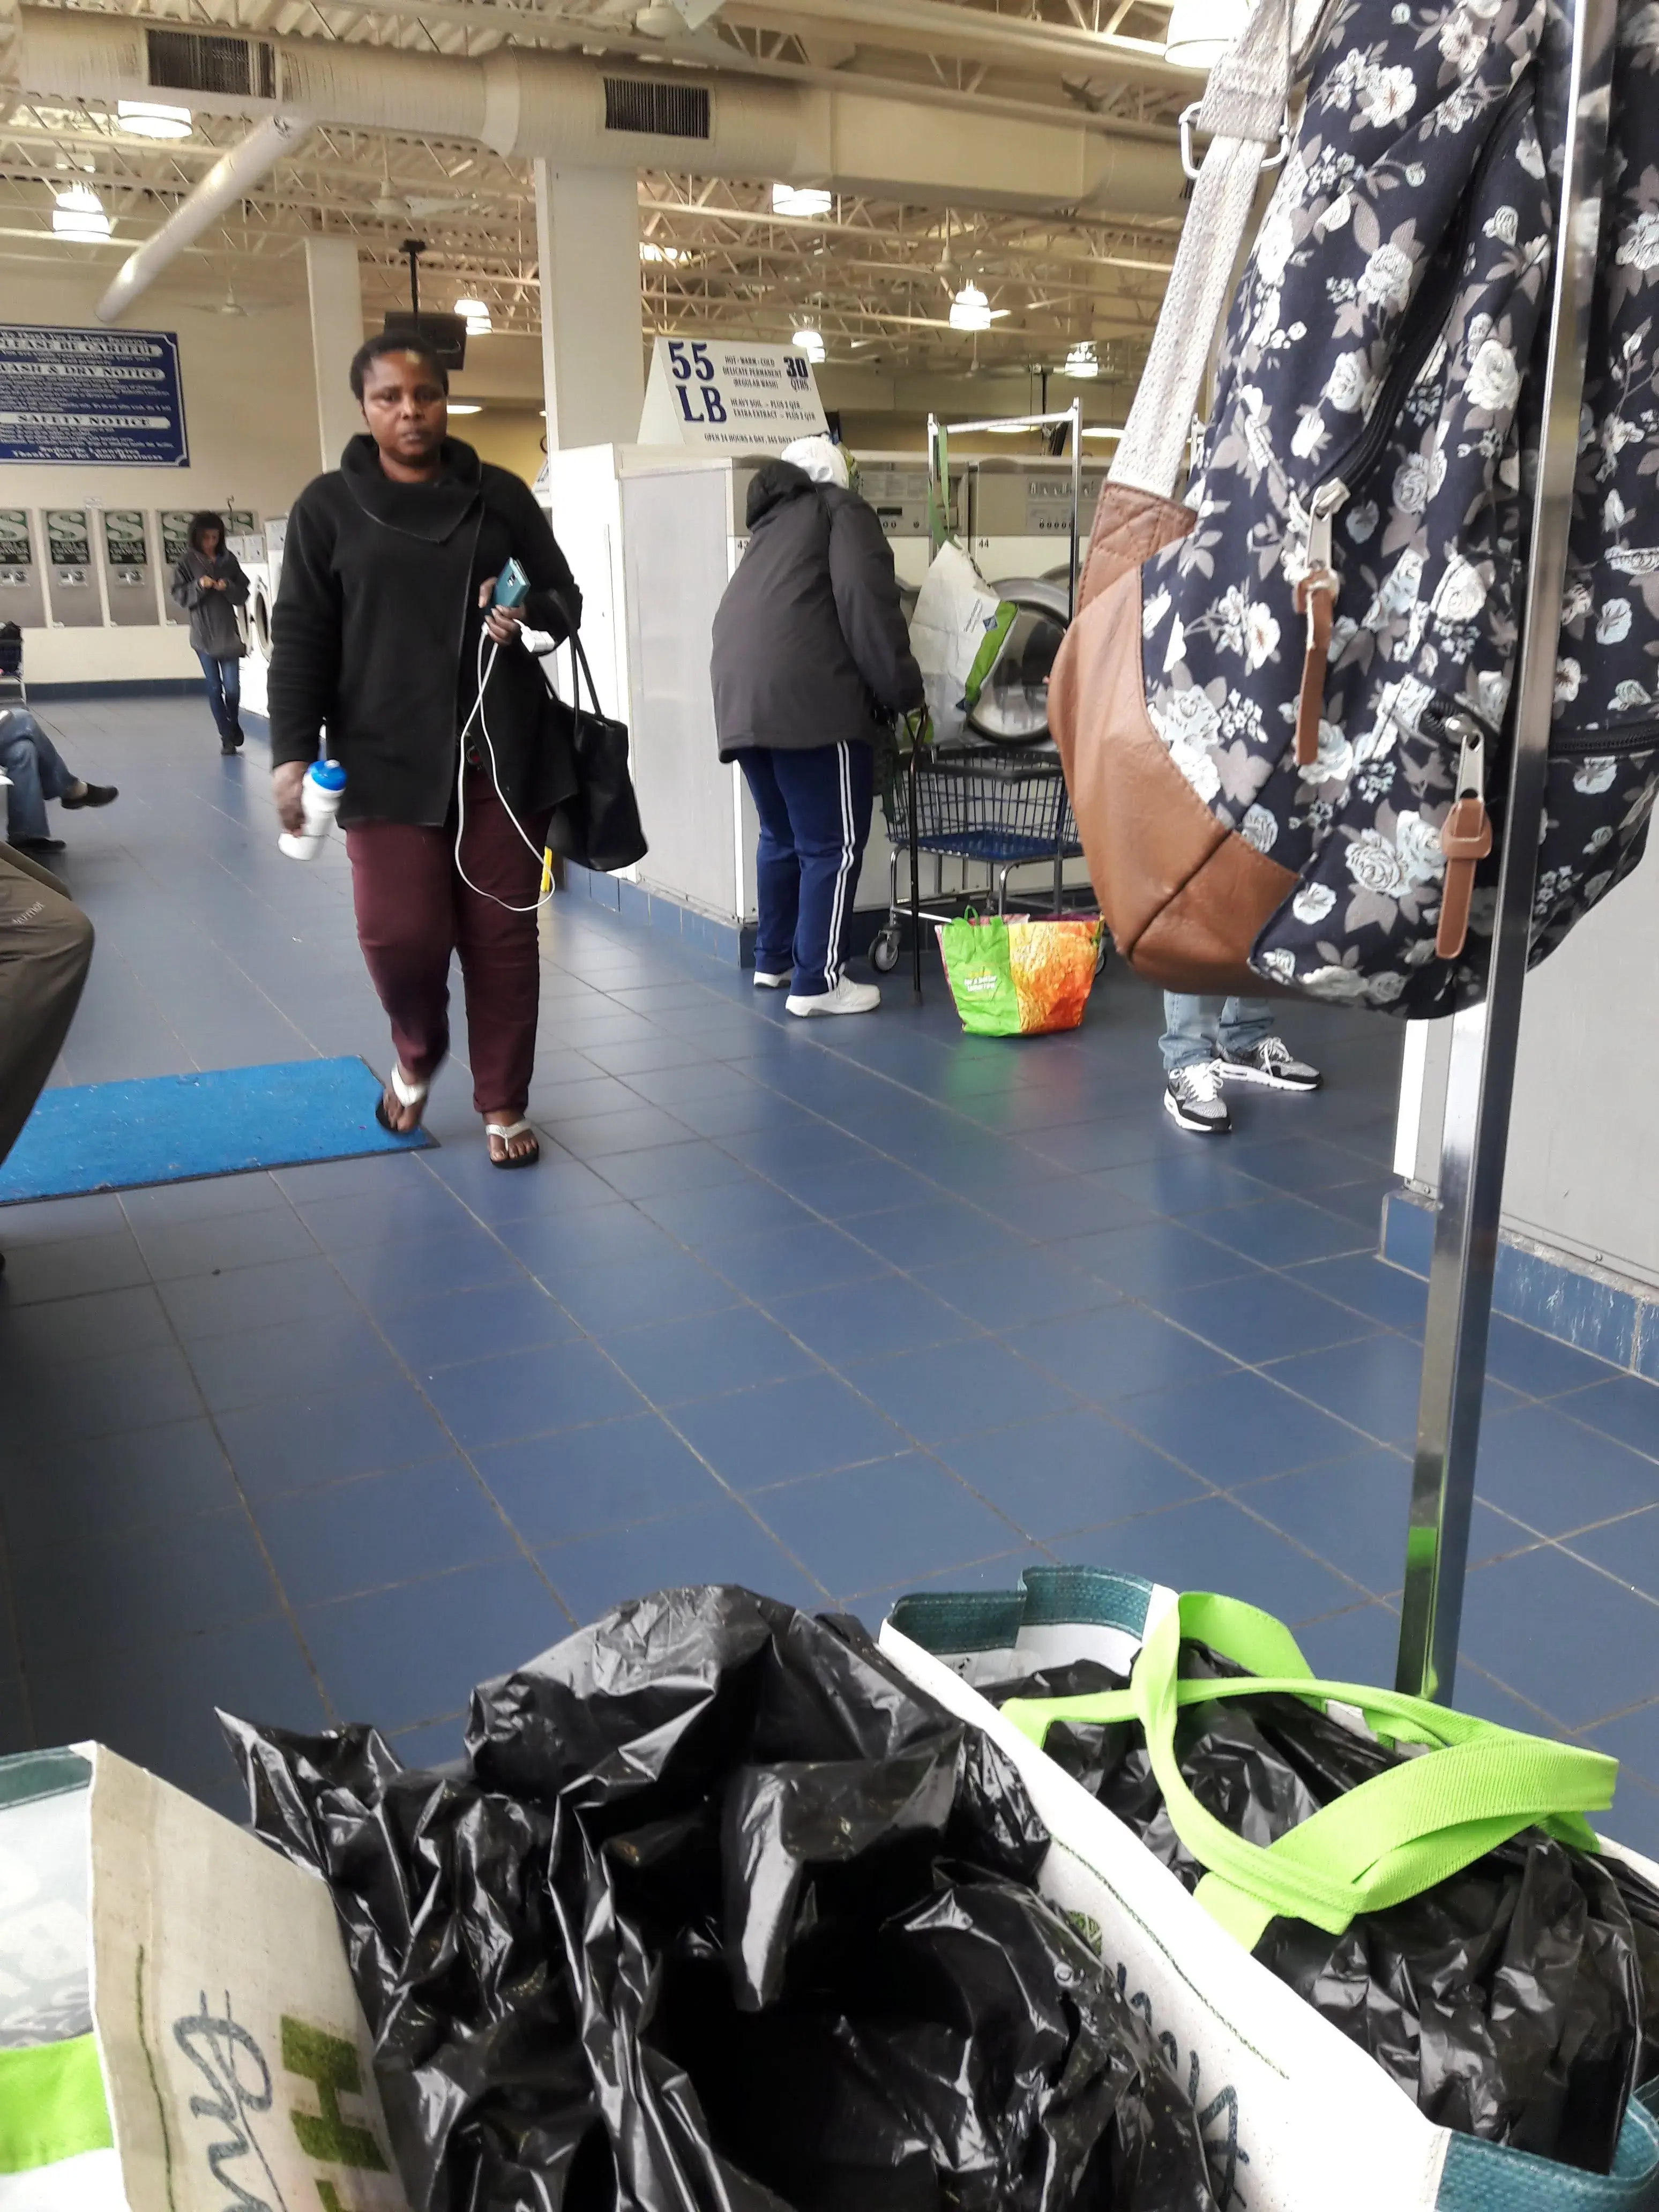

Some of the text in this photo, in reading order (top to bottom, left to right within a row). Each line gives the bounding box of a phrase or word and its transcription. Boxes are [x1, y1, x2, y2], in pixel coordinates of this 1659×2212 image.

[668, 341, 714, 381] 55
[724, 355, 736, 364] HOT
[760, 357, 775, 367] COLD
[783, 356, 809, 378] 30
[102, 368, 158, 378] NOTICE
[675, 385, 727, 422] LB
[88, 416, 151, 425] NOTICE
[704, 433, 720, 442] OPEN
[729, 434, 749, 443] HOURS
[978, 539, 989, 548] 44
